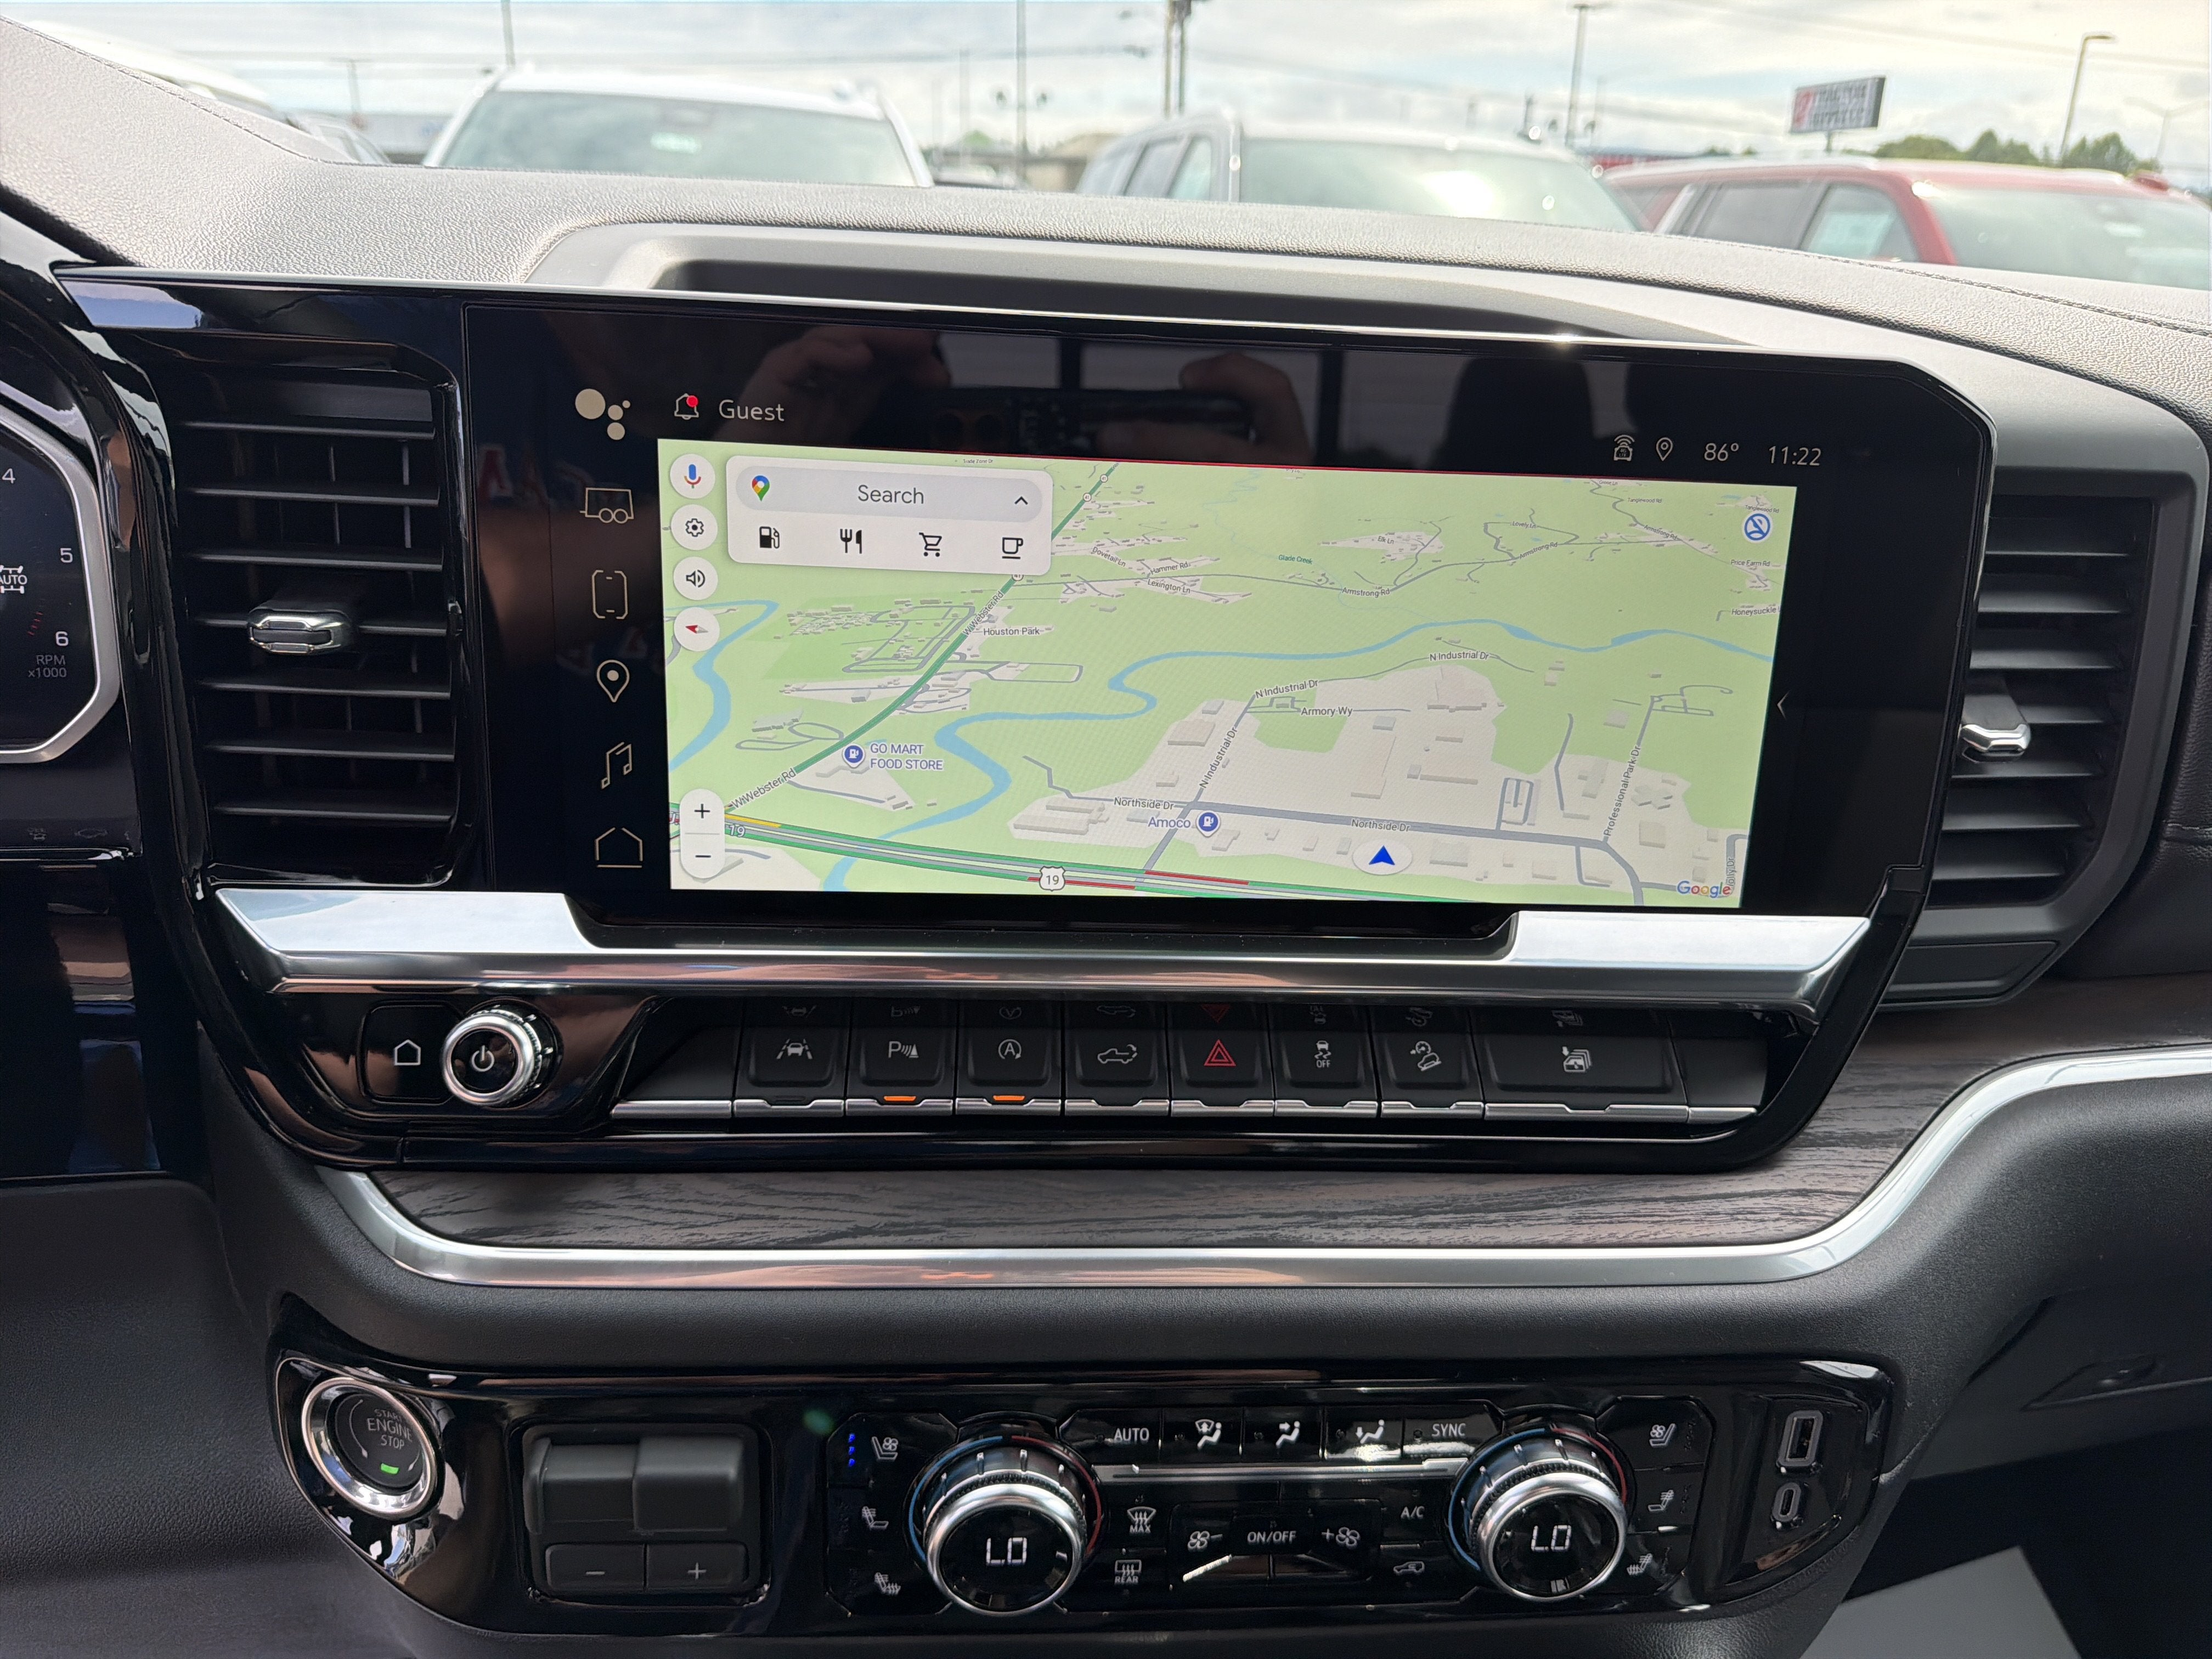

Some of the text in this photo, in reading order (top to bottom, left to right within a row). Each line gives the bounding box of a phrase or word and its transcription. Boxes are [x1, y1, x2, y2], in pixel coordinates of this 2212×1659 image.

[719, 399, 785, 421] Guest
[1769, 445, 1822, 466] 11:22
[2, 468, 16, 484] 4
[858, 485, 924, 504] Search
[1644, 525, 1670, 538] Armstrong
[60, 548, 73, 563] 5
[1092, 546, 1126, 567] Dovetail Ln
[1520, 544, 1549, 559] Armstrong
[1150, 561, 1189, 575] Hammer Rd
[1148, 579, 1182, 592] Lexington
[1342, 587, 1379, 597] Armstrong
[963, 591, 1004, 635] W Webster Rd
[1731, 606, 1776, 617] Honeysuckle
[55, 631, 69, 646] 6
[983, 627, 1040, 636] Houston Park
[36, 654, 65, 665] RPM
[1430, 651, 1489, 661] N Industrial Dr
[28, 667, 67, 678] x1000
[1255, 679, 1318, 699] N Industrial Dr
[1301, 706, 1353, 717] Armory Wy
[870, 743, 924, 754] GO MART
[870, 758, 943, 770] FOOD STORE
[1199, 727, 1238, 788] N Industrial Dr
[731, 768, 796, 809] W Webster Rd
[1603, 745, 1641, 836] Professional Park Dr
[1114, 797, 1174, 810] Northside Dr
[1148, 816, 1191, 828] Amoco
[1351, 819, 1410, 832] Northside Dr
[729, 824, 746, 838] 19
[1726, 856, 1734, 866] Dr
[1046, 875, 1059, 885] 19
[1677, 880, 1731, 899] Google
[1316, 1059, 1330, 1068] OFF
[367, 1418, 413, 1442] ENGINE
[1114, 1427, 1150, 1443] AUTO
[1431, 1423, 1466, 1437] SYNC
[381, 1434, 405, 1450] STOP
[1401, 1506, 1425, 1520] A/C
[1129, 1525, 1152, 1533] MAX
[1247, 1531, 1296, 1543] ON/OFF
[1114, 1575, 1139, 1584] REAR
